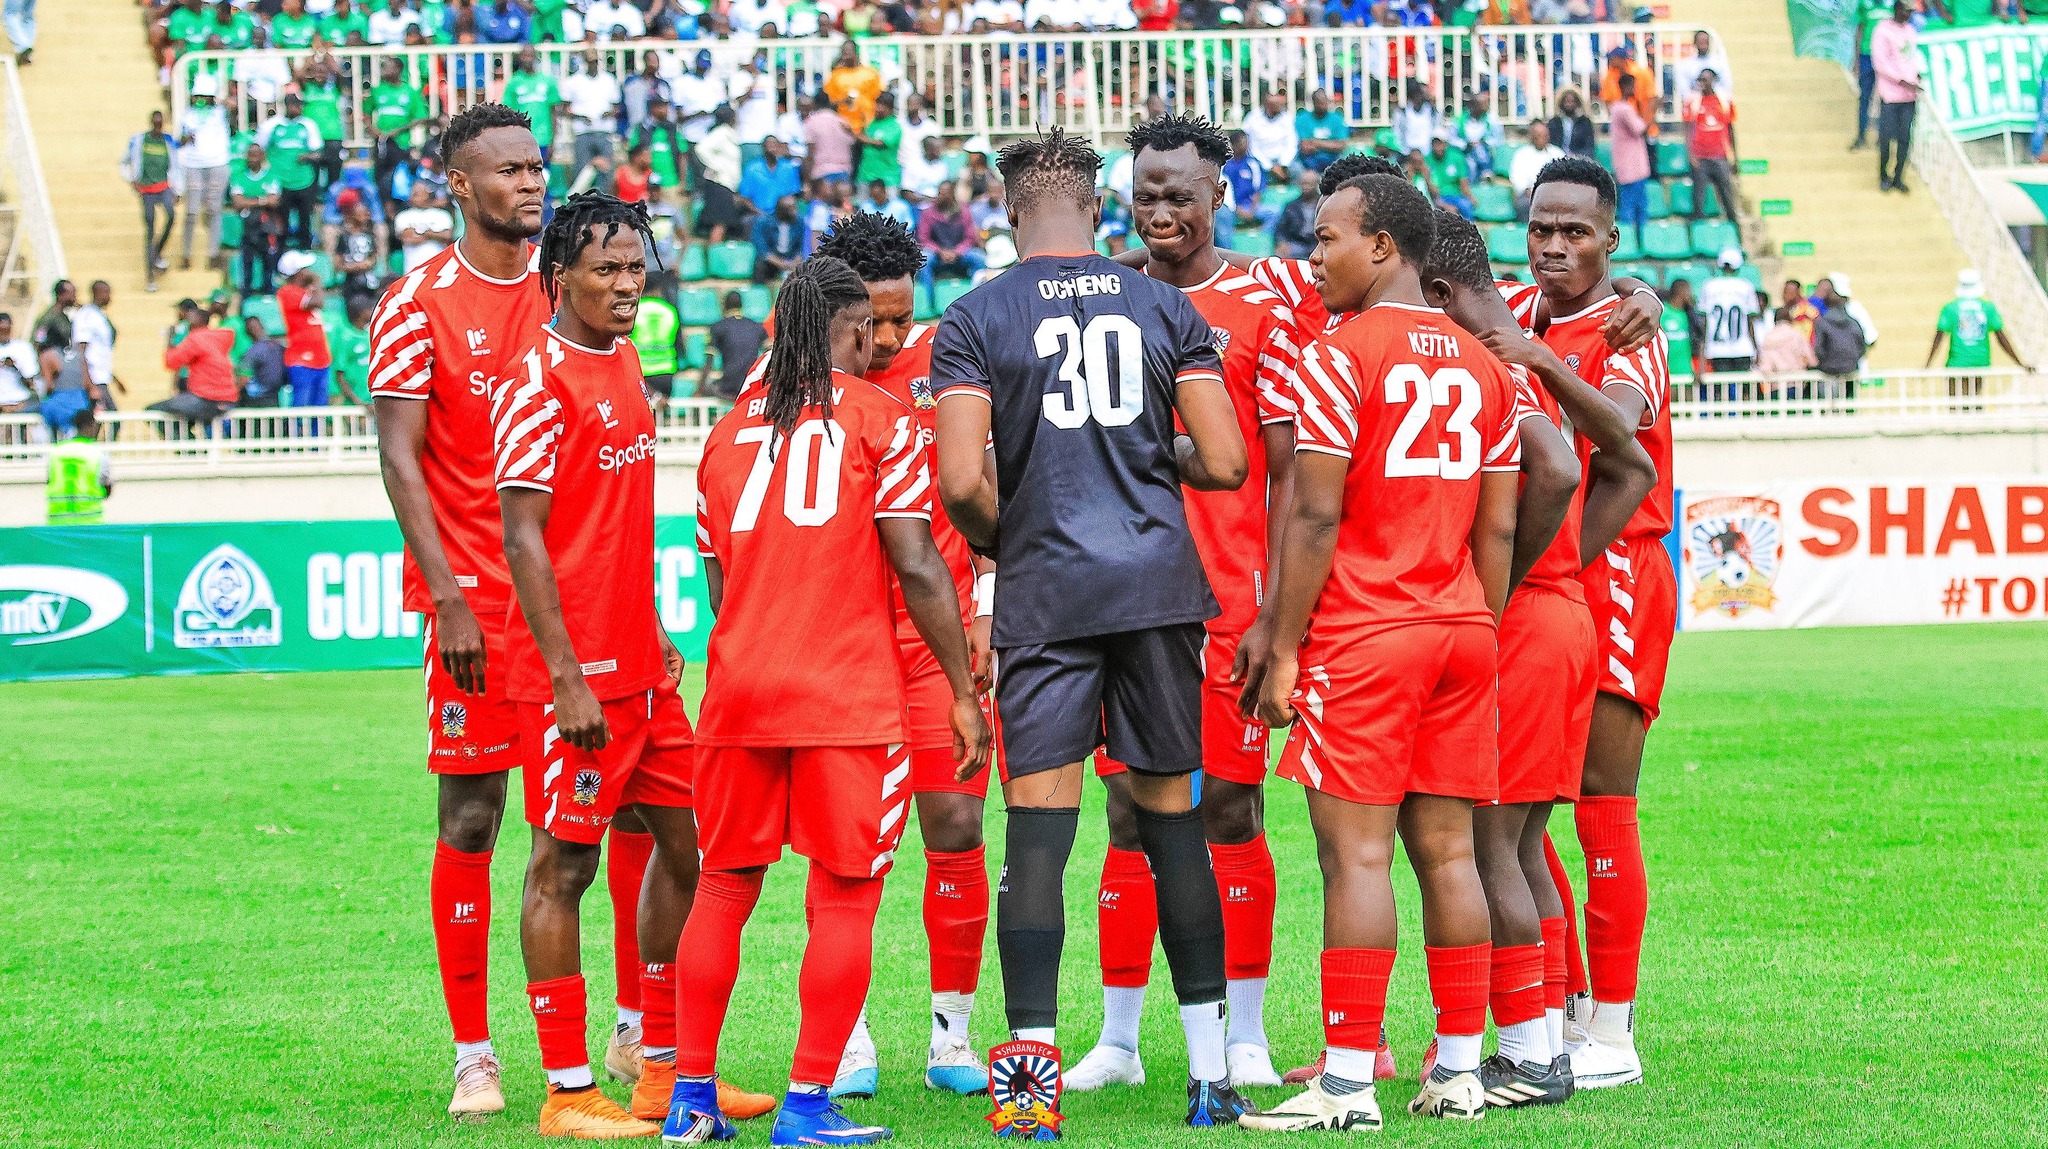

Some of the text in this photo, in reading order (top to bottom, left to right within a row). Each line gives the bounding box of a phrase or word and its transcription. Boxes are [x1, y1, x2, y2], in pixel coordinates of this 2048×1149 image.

[1407, 331, 1460, 358] KEITH
[1712, 305, 1741, 341] 20
[1033, 315, 1144, 429] 30
[1384, 364, 1482, 480] 23
[598, 433, 657, 475] SpotPe
[730, 419, 846, 533] 70
[1800, 487, 2048, 556] SHAB
[307, 553, 419, 640] GOR
[654, 546, 697, 633] C
[1942, 577, 2048, 617] #TO
[484, 743, 509, 754] CASINO
[561, 814, 585, 823] FINIX
